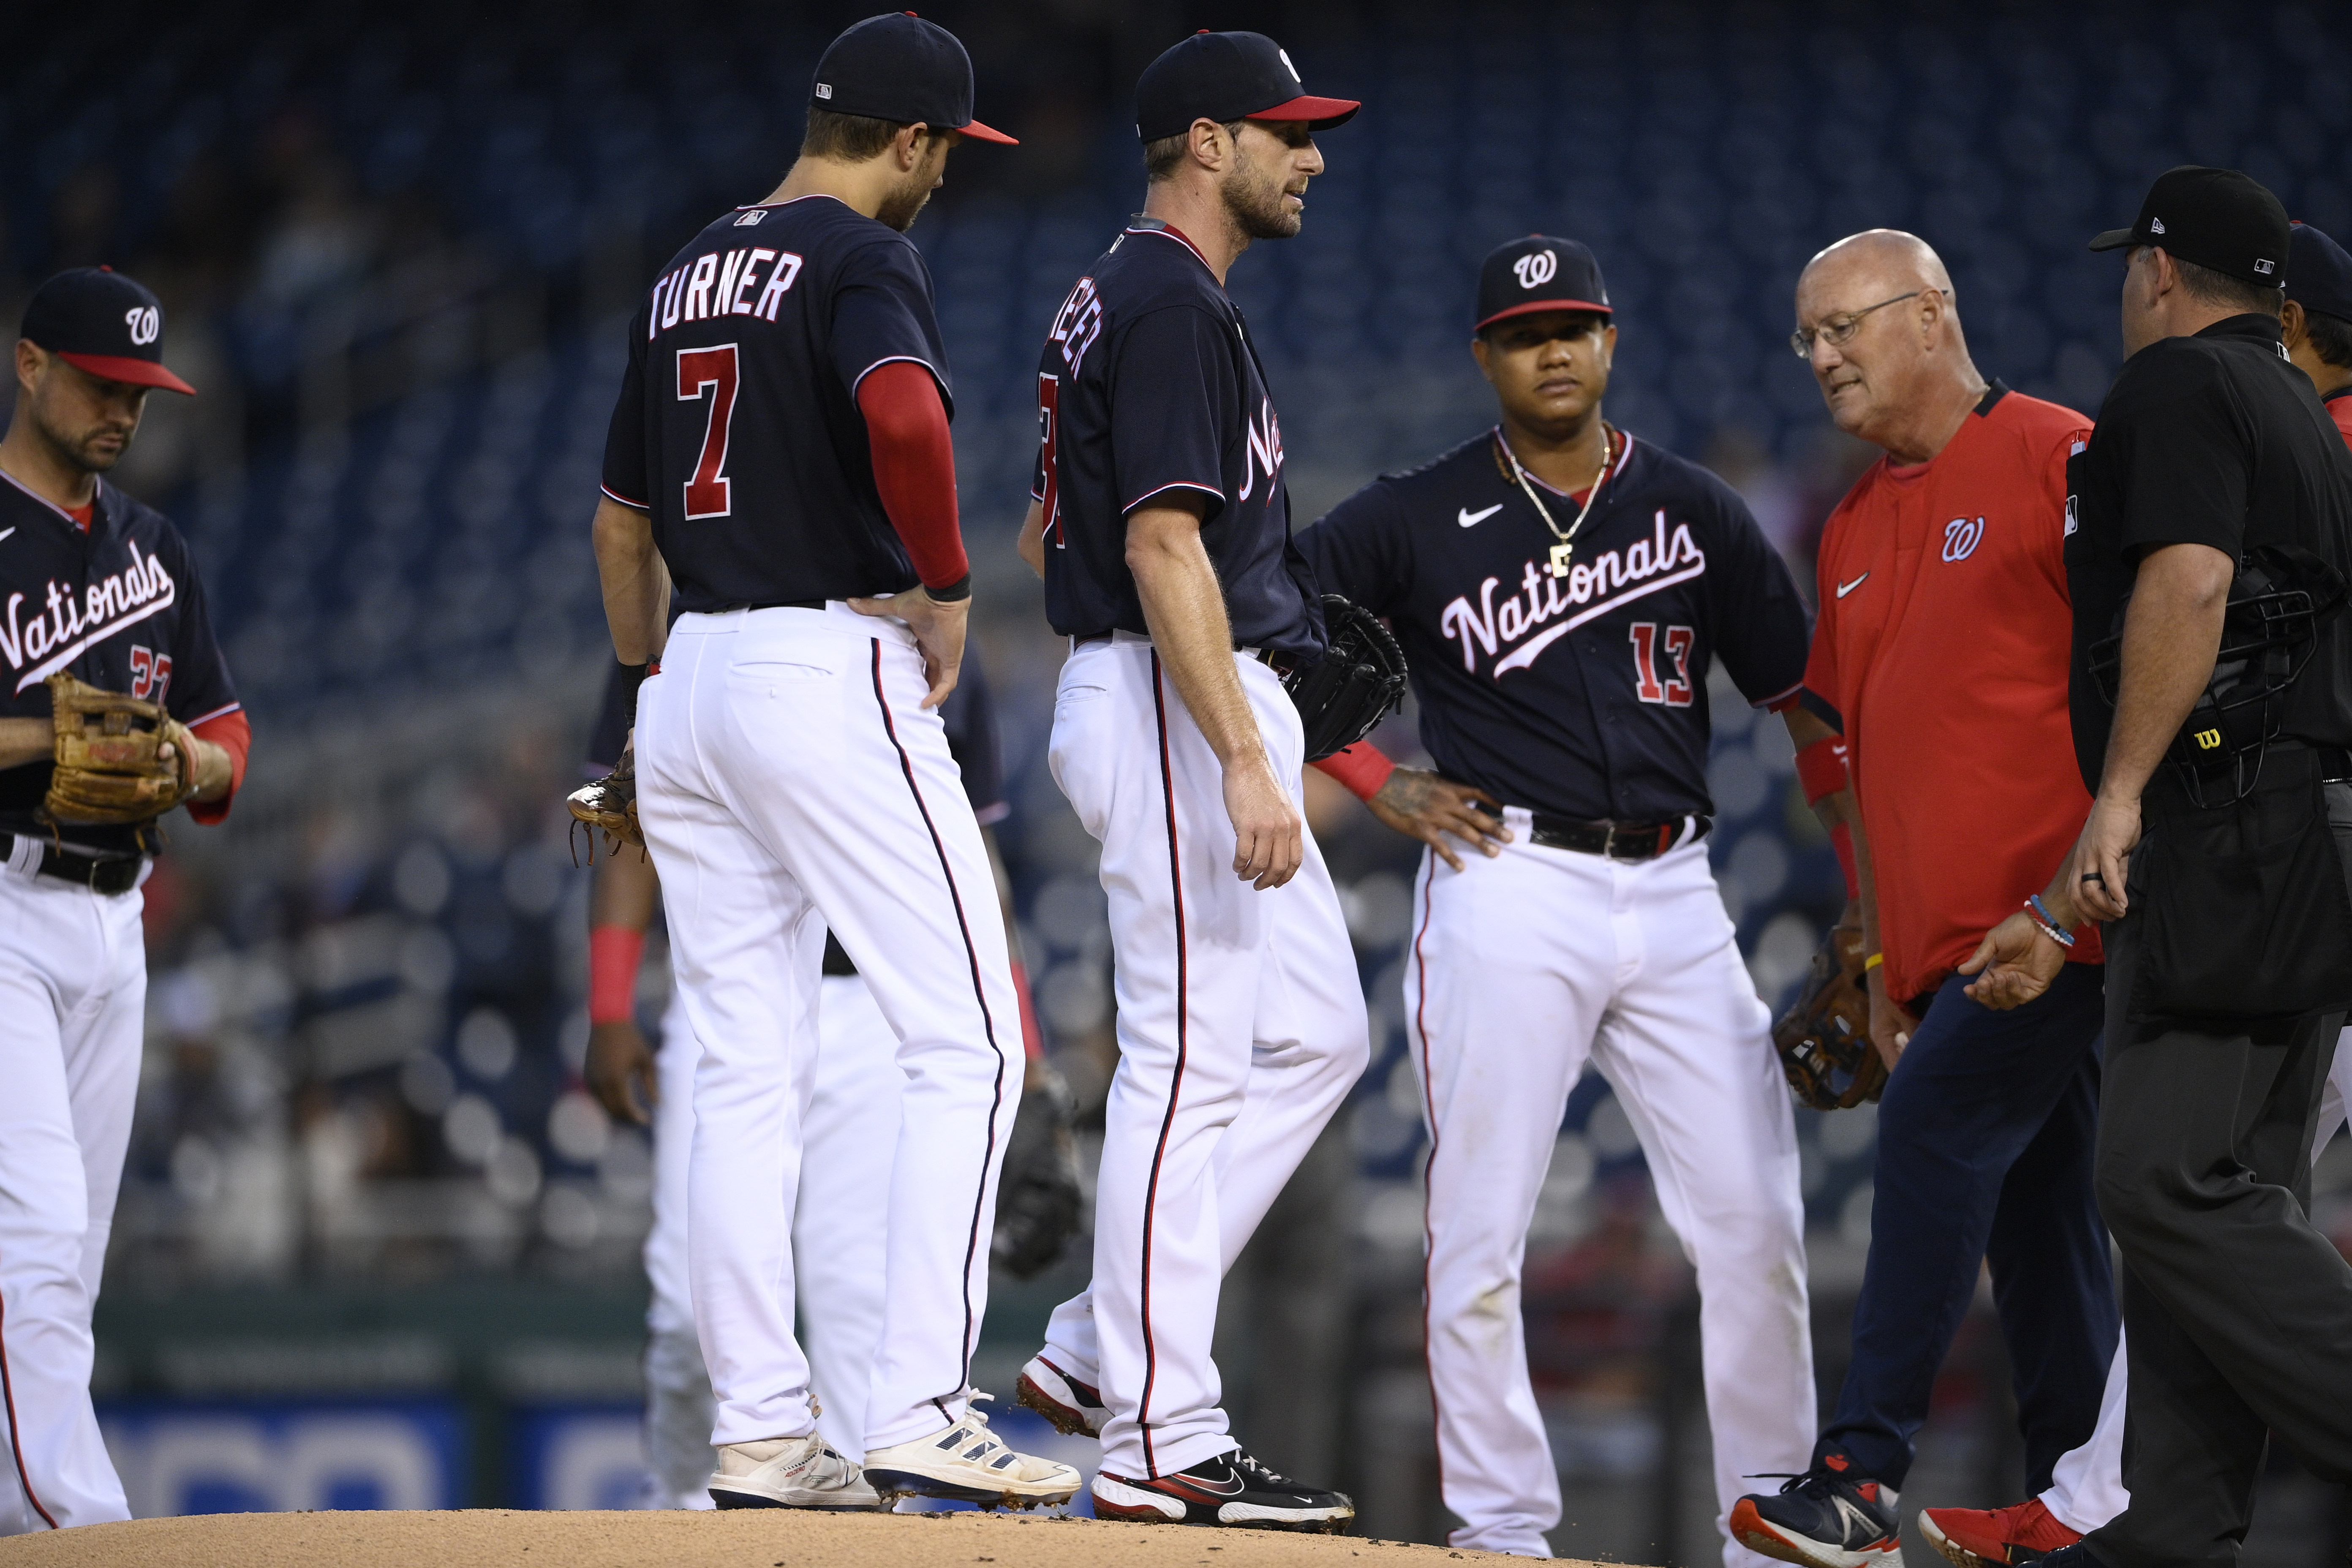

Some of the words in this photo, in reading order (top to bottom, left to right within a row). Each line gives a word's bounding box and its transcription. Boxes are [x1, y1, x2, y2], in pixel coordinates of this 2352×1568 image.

[648, 247, 804, 343] TURNER
[1513, 249, 1557, 290] W
[126, 305, 160, 346] W
[676, 343, 740, 521] 7
[1942, 515, 1985, 564] W
[1440, 507, 1706, 683] Nationals
[130, 643, 172, 707] 27
[1629, 622, 1694, 707] 13
[784, 1465, 806, 1478] ADIZERO
